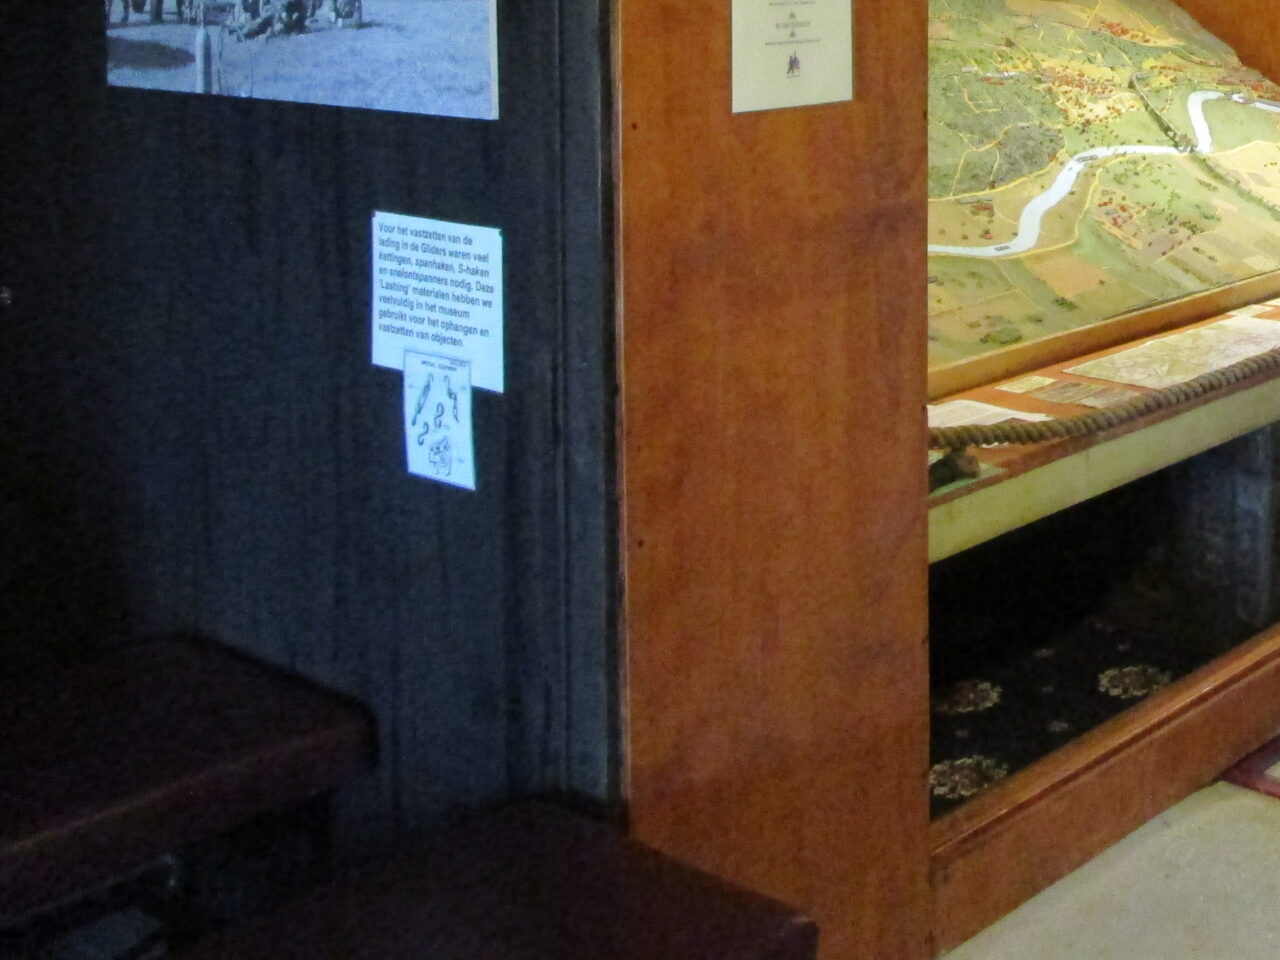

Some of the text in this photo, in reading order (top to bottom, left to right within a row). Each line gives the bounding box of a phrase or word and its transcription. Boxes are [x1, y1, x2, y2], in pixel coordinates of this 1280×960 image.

[379, 223, 472, 245] Voor het vastzetten van de
[379, 237, 489, 263] lading in de Gliders waren veel
[379, 267, 387, 275] en
[476, 281, 494, 293] Deze
[458, 264, 489, 277] S-haken
[379, 294, 469, 318] veelvuldig in het museum
[413, 285, 450, 300] materialen
[452, 291, 480, 306] hebben
[482, 299, 492, 308] we
[379, 309, 489, 337] gebruikt voor het ophangen en
[379, 323, 414, 336] vastzetten
[416, 329, 429, 339] van
